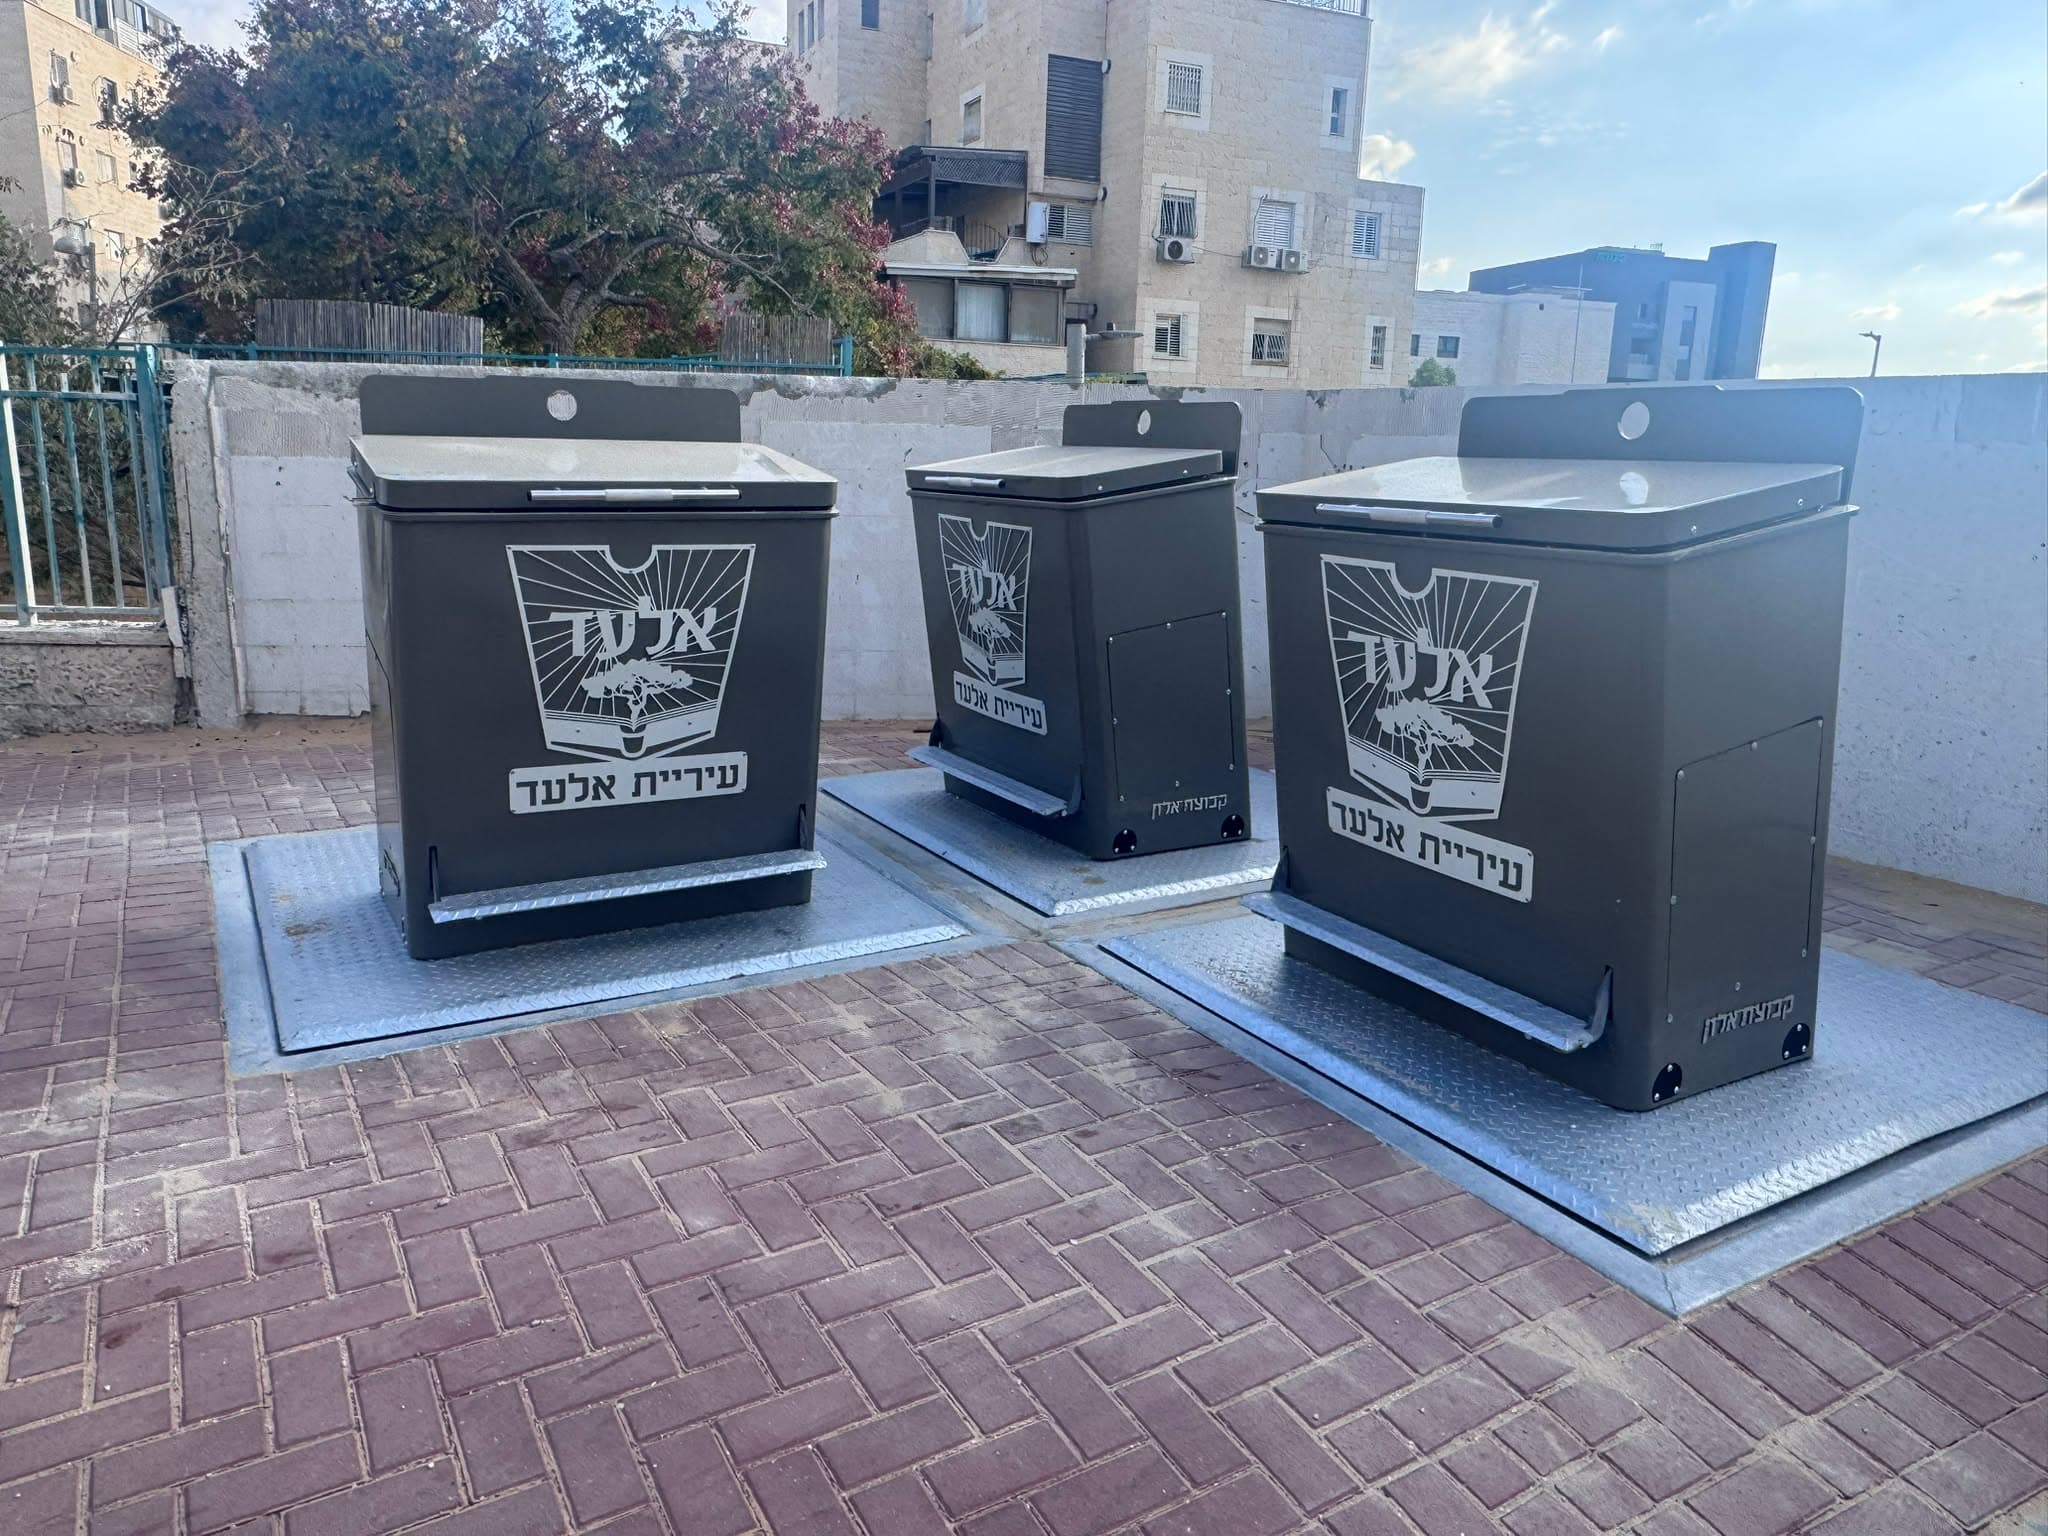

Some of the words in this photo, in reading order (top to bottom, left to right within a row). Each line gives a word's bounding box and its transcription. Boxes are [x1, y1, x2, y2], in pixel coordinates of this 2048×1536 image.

[952, 560, 1016, 611] אלעד
[549, 596, 717, 660] אלעד
[1347, 627, 1493, 709] אלעד
[955, 680, 989, 712] אלעד
[994, 695, 1043, 729] עיריית
[515, 772, 616, 807] אלעד
[631, 764, 739, 798] עיריית
[1331, 801, 1406, 853] אלעד
[1418, 831, 1523, 893] עיריית
